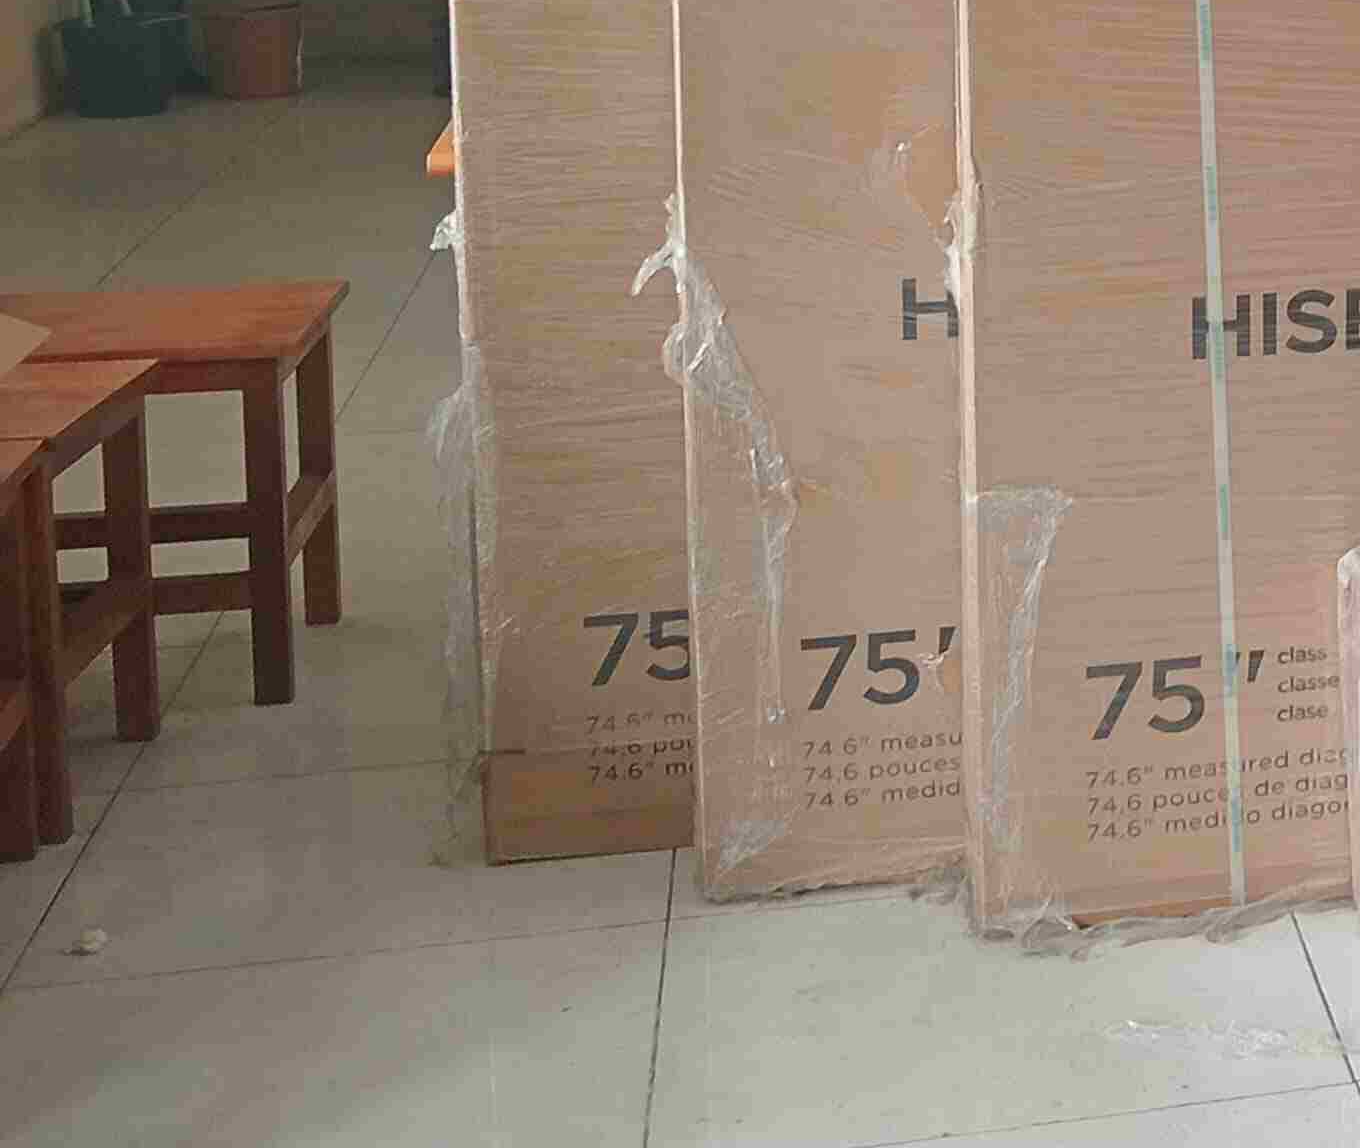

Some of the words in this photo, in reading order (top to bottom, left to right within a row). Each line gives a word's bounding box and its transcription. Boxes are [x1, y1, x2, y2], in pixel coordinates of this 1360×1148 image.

[1276, 644, 1329, 665] class
[1276, 674, 1341, 695] classe
[1276, 703, 1329, 723] clase
[869, 754, 961, 781] pouces
[1087, 794, 1142, 817] 74,6
[1254, 780, 1286, 798] de
[1164, 809, 1261, 835] medio
